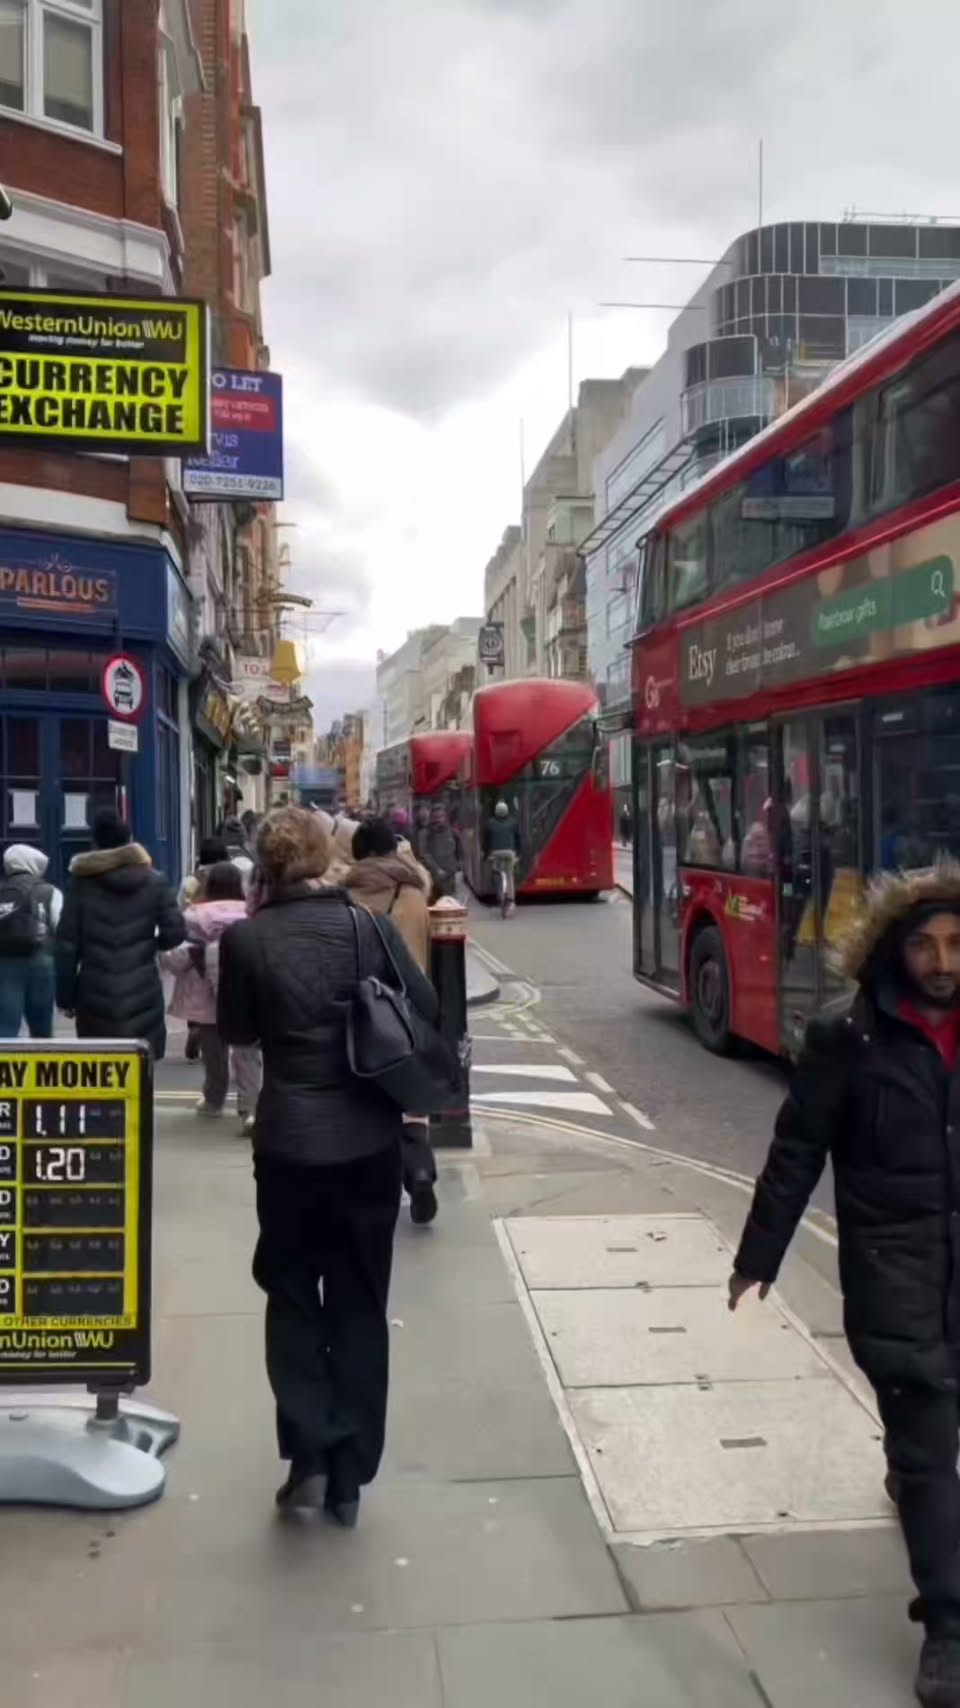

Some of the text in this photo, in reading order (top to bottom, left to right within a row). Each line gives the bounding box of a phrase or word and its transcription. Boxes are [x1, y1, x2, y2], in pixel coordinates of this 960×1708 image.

[0, 357, 188, 399] CURRENCY
[211, 373, 263, 392] O LET
[0, 567, 109, 602] PARLOUS
[688, 644, 717, 686] Etsy
[540, 760, 560, 776] 76
[36, 1061, 130, 1088] MONEY
[36, 1104, 86, 1136] 1.11
[36, 1148, 86, 1181] 1.20
